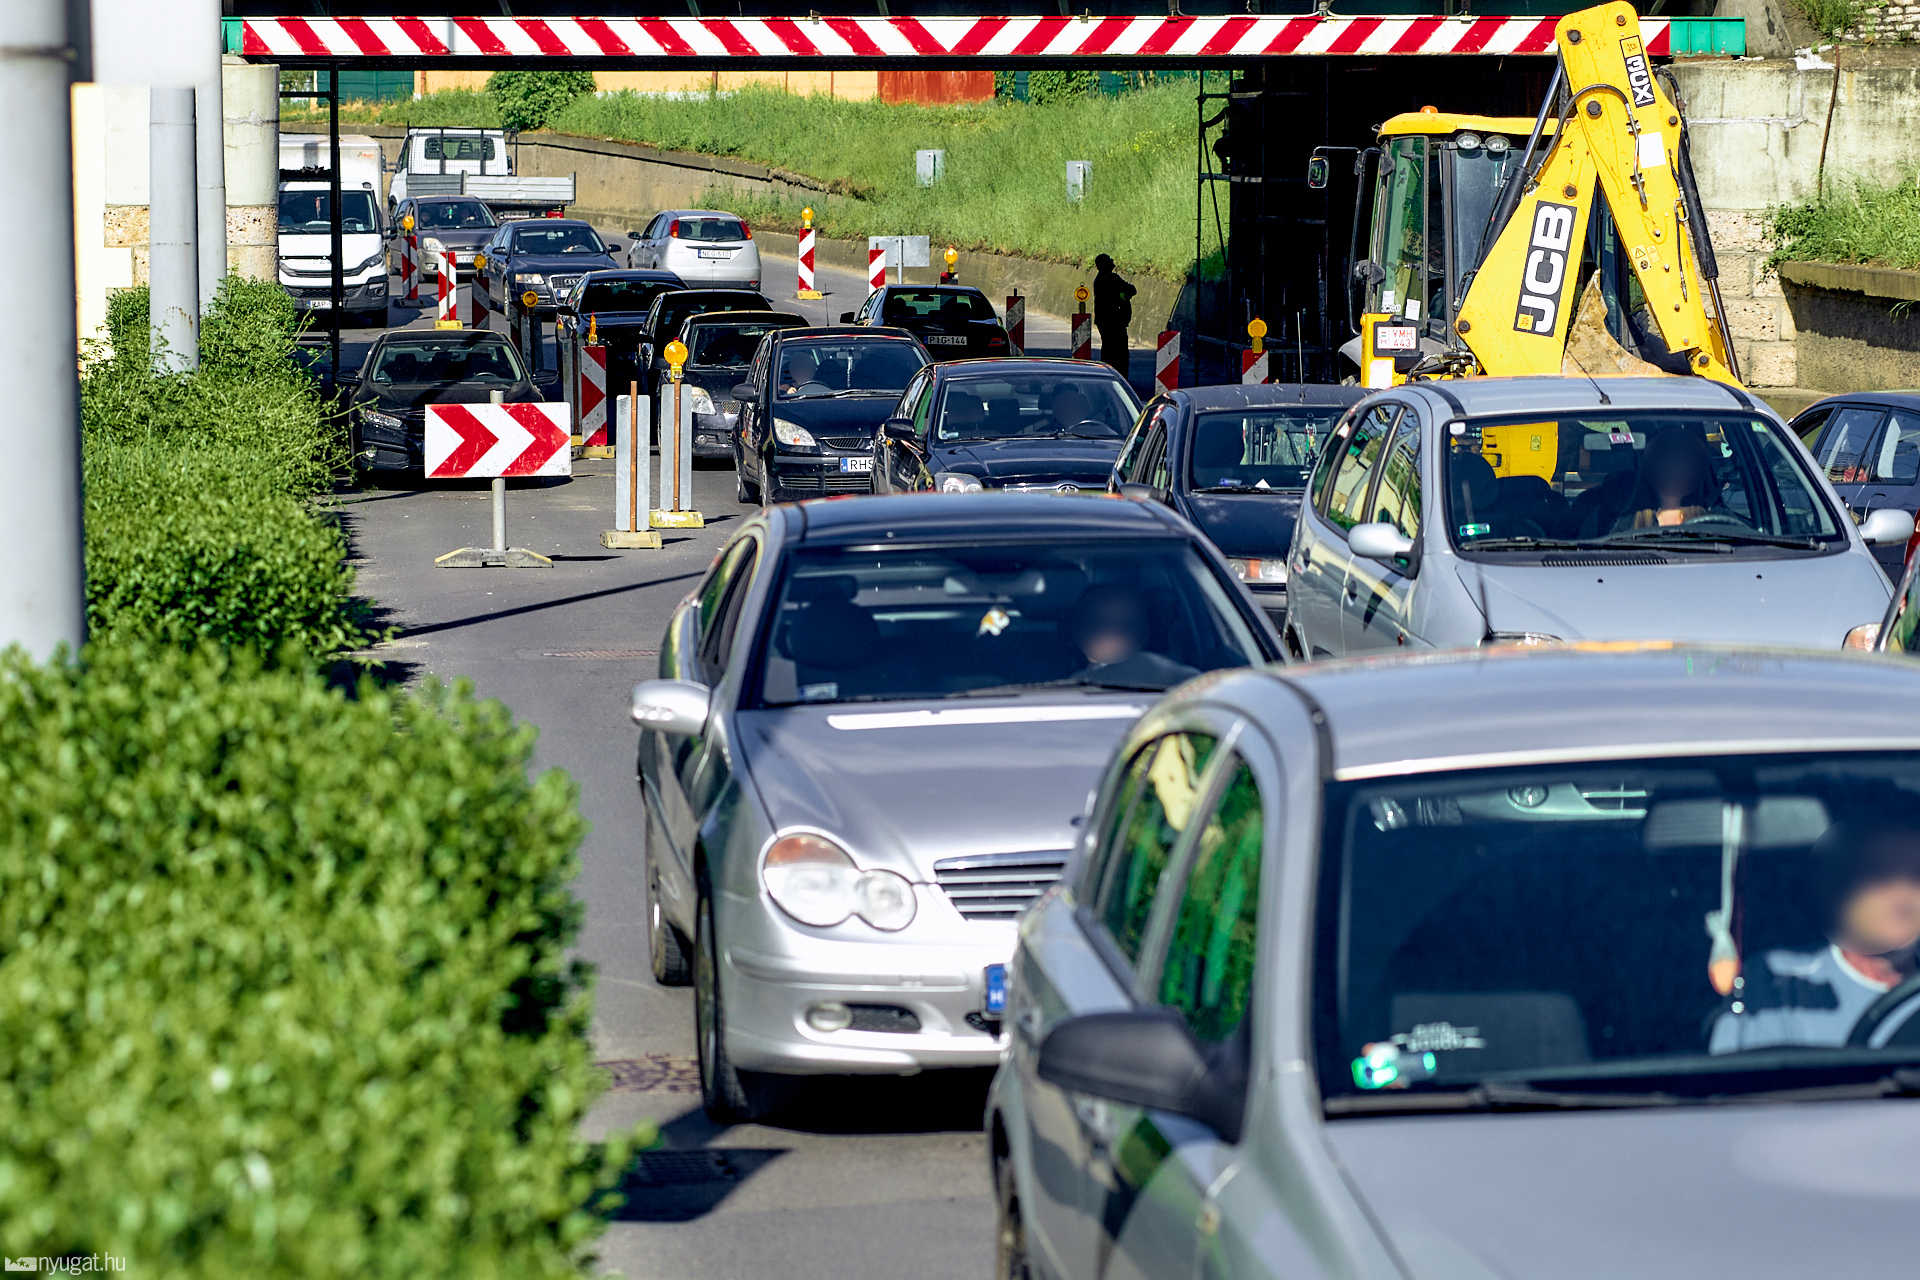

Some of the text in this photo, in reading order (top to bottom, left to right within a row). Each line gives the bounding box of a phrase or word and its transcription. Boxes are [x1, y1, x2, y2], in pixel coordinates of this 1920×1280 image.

[1626, 55, 1655, 105] 3CX
[1519, 204, 1573, 333] JCB
[929, 336, 966, 345] PIG-144
